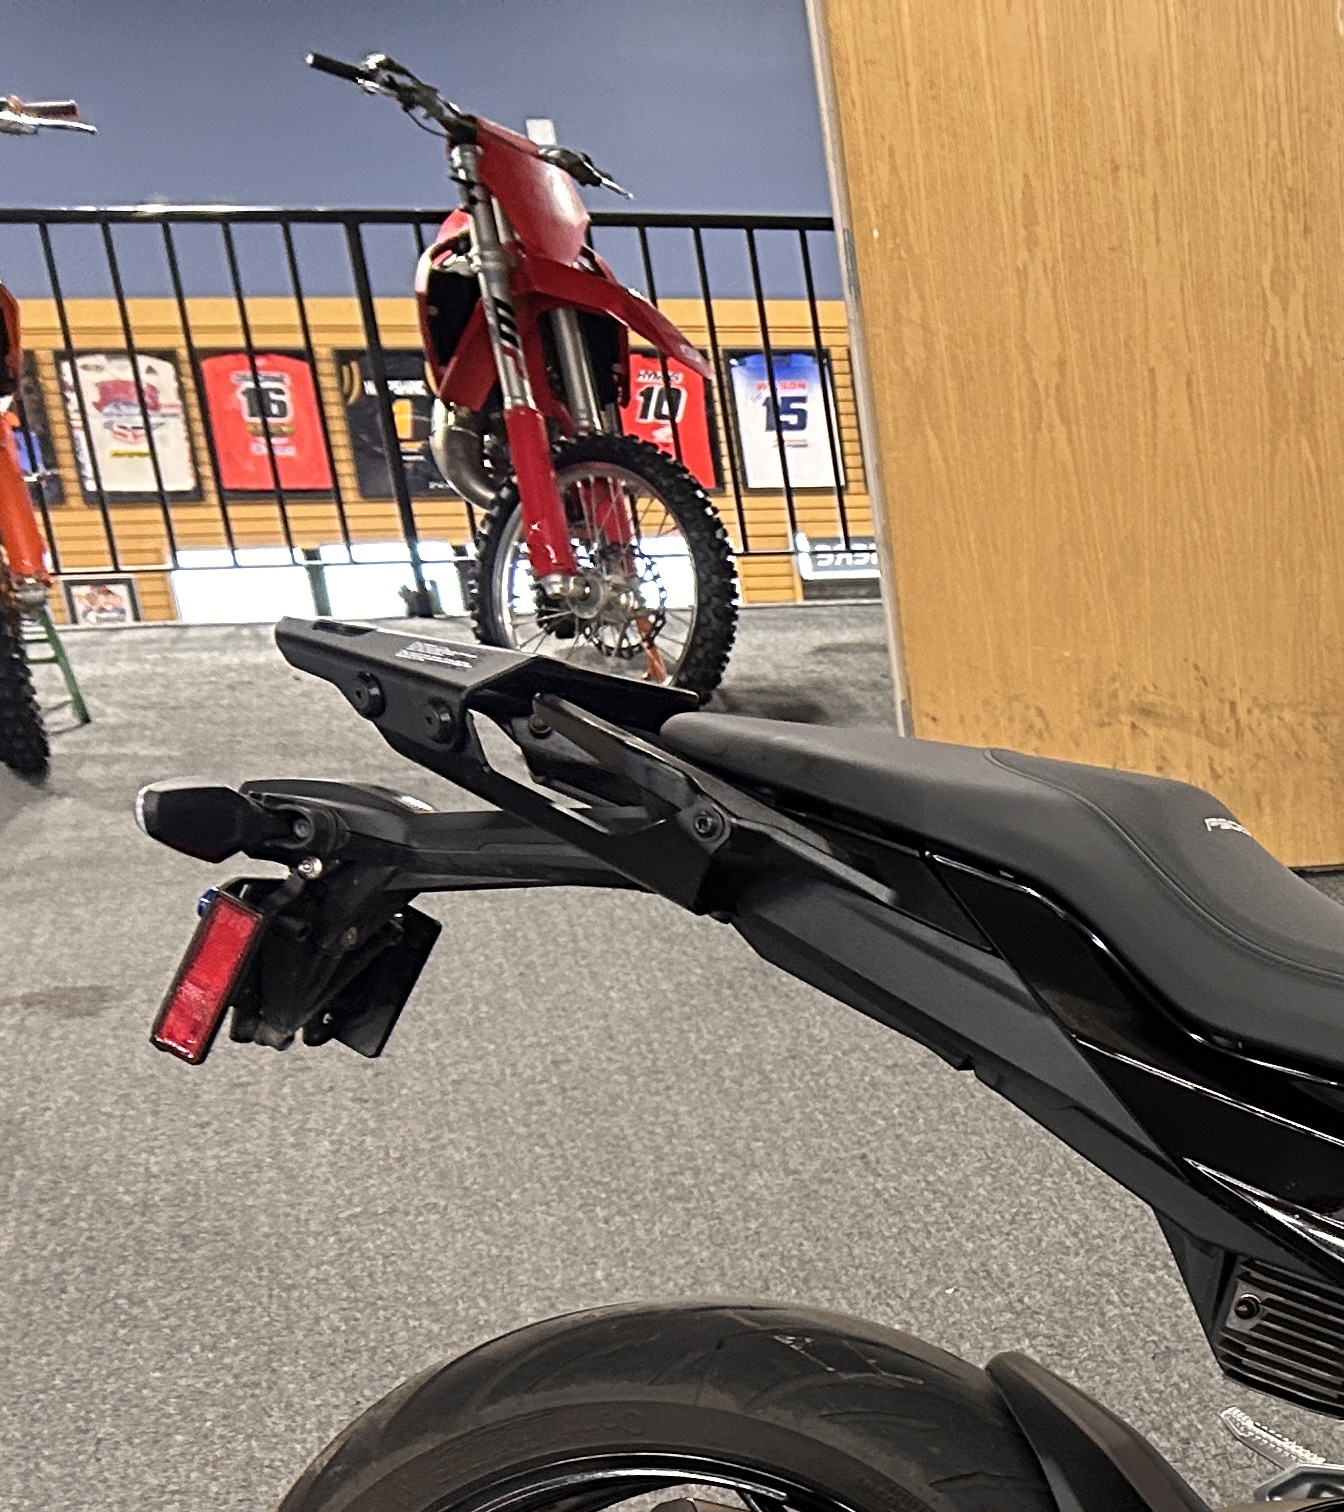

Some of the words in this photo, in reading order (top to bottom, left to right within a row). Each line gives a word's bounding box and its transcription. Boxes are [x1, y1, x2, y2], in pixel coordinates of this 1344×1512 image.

[241, 388, 288, 418] 16
[637, 386, 682, 422] 10
[761, 395, 808, 432] 15
